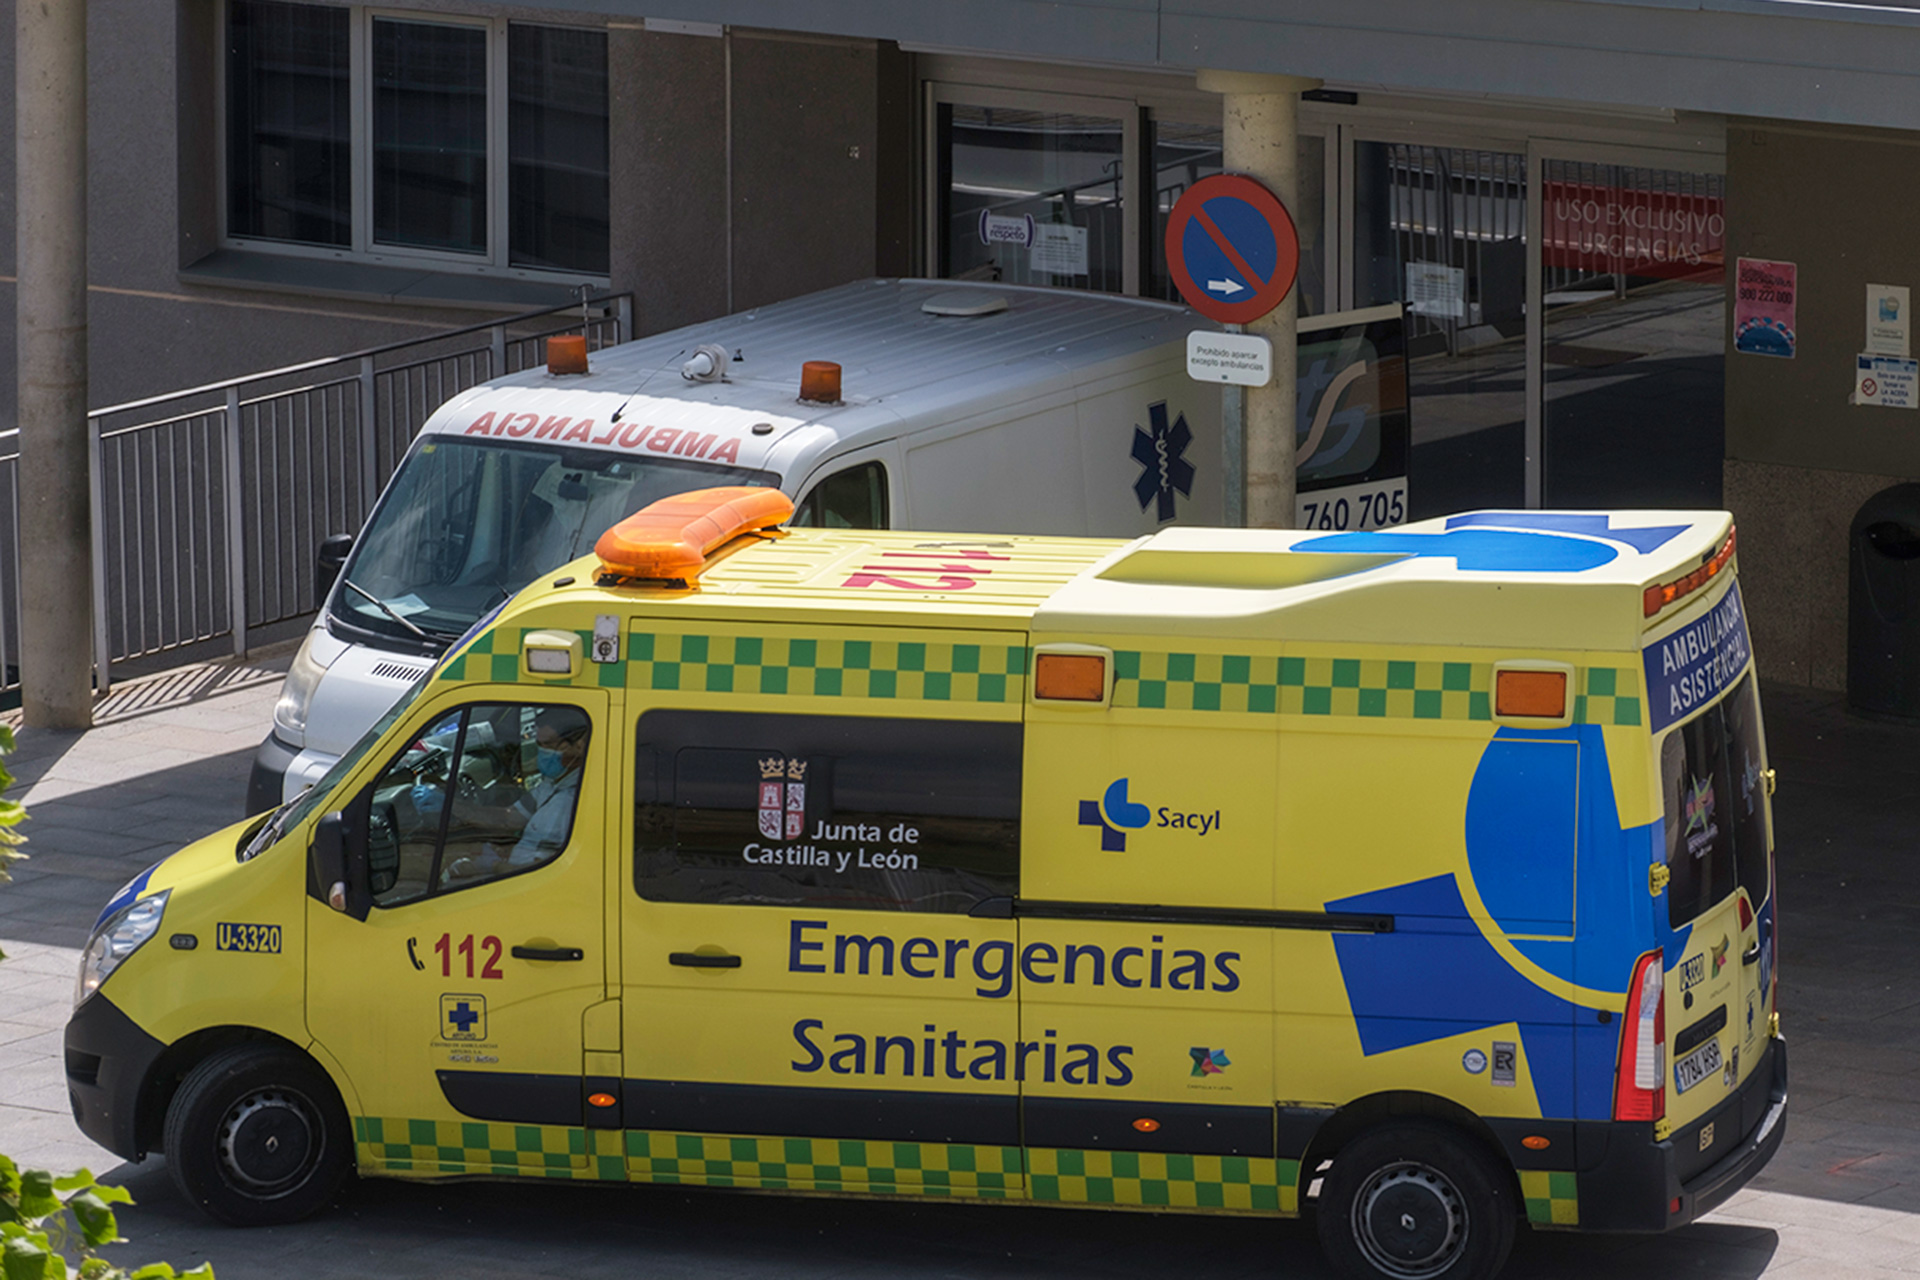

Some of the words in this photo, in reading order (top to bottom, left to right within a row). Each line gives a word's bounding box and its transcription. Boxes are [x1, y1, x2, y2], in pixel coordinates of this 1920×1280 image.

[1556, 197, 1600, 224] USO
[1606, 202, 1725, 237] EXCLUSIVO
[990, 229, 1026, 240] respeto
[1578, 231, 1701, 266] URGENCIAS
[1191, 357, 1219, 367] excepto
[1220, 359, 1264, 371] ambulancias
[1196, 346, 1230, 358] Prohibido
[1231, 351, 1258, 360] aparcar
[1303, 498, 1349, 531] 760
[1359, 489, 1404, 526] 705
[811, 820, 881, 842] Junta
[888, 823, 919, 844] de
[1156, 806, 1220, 836] Sacyl
[743, 843, 830, 866] Castilla
[835, 851, 851, 873] y
[858, 849, 918, 870] León
[218, 924, 280, 952] U-3320
[434, 933, 503, 979] 112
[788, 919, 1241, 998] Emergencias
[790, 1019, 1134, 1086] Sanitarias
